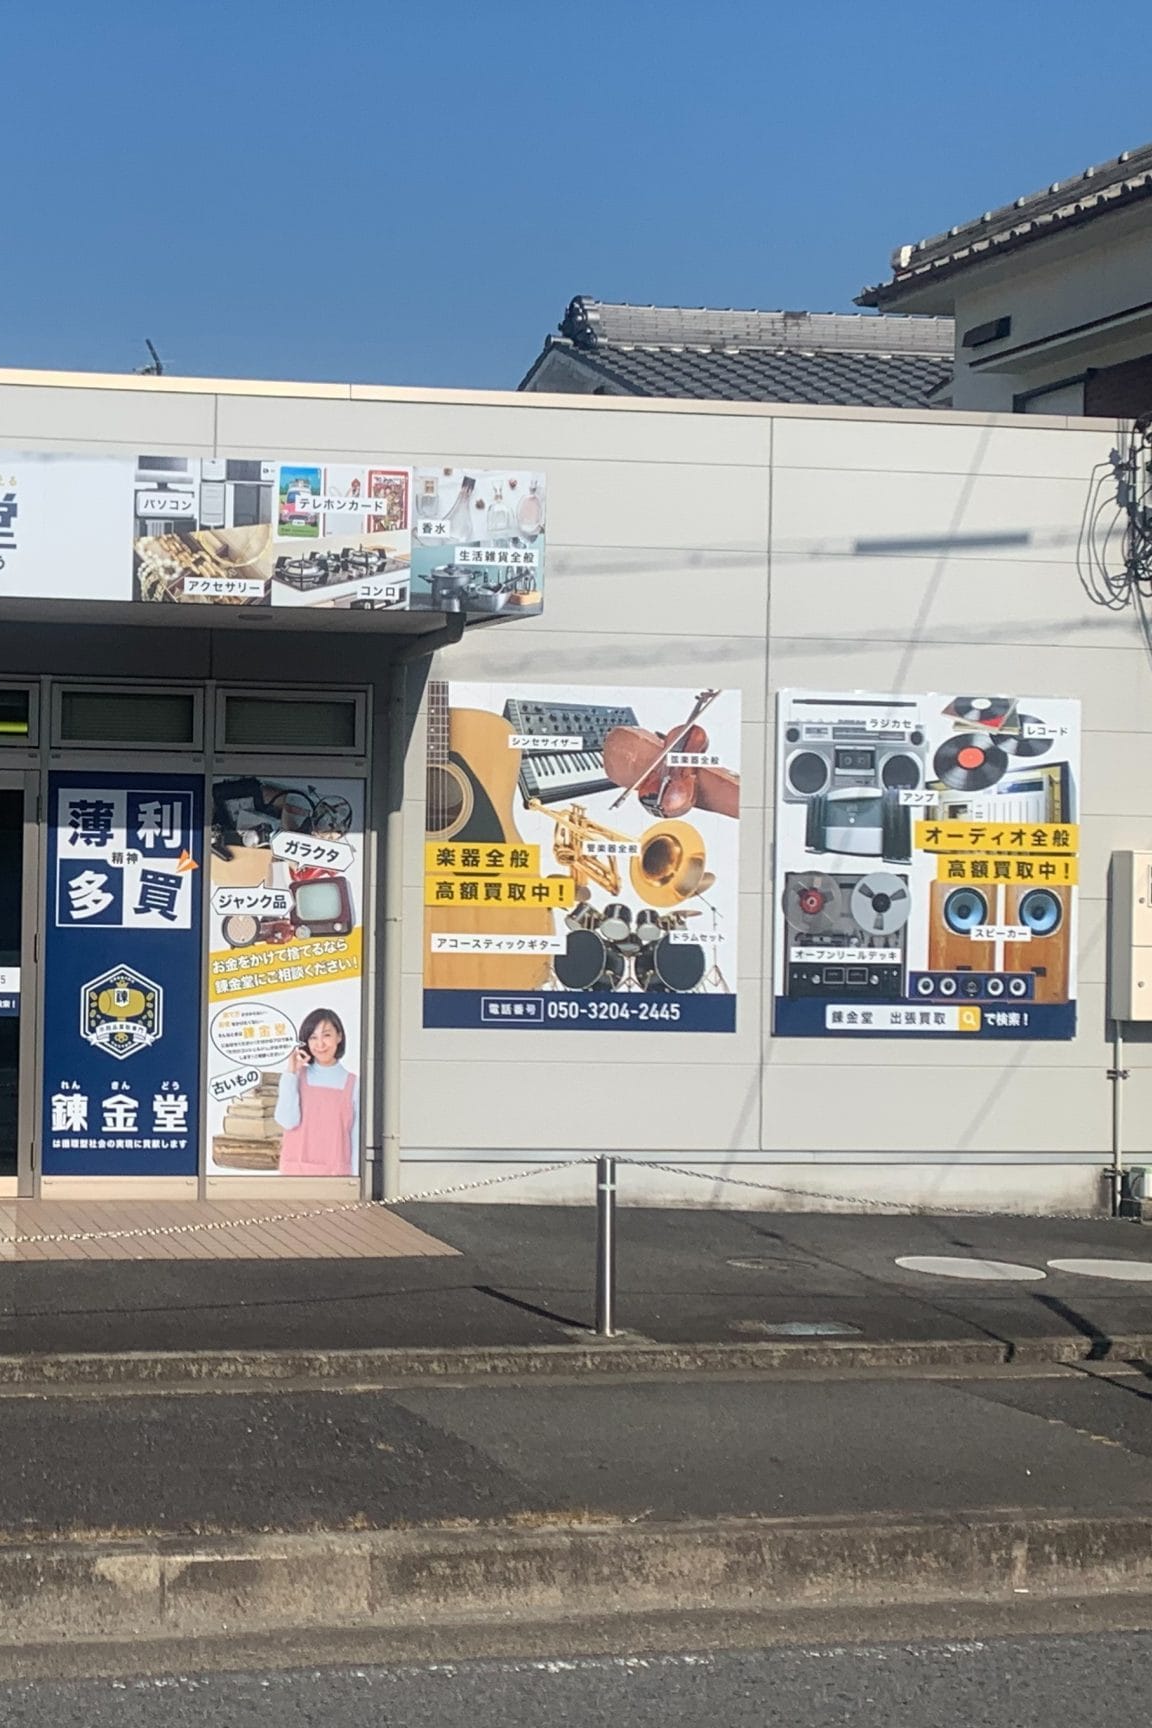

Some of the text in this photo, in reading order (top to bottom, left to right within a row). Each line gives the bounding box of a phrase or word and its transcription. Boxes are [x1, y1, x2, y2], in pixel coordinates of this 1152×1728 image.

[144, 498, 193, 512] パソコン
[299, 498, 383, 511] テレホンカード
[421, 521, 446, 535] 香水
[459, 549, 535, 564] 生活雑貨全般
[189, 580, 260, 594] アクセサリー
[360, 586, 396, 598] コンロ
[869, 719, 912, 729] ラジカセ
[1027, 726, 1068, 736] レコード
[512, 737, 579, 747] シンセサイザー
[903, 792, 935, 803] アンプ
[925, 827, 1070, 848] オーディオ全般
[284, 839, 340, 862] ガラクタ
[112, 852, 138, 864] 精神
[437, 848, 529, 868] 楽器全般
[948, 860, 1070, 880] 高額買取中！
[436, 881, 565, 902] 高額買取中！
[219, 895, 287, 910] ジャンク品
[672, 932, 725, 943] ドラムセット
[975, 927, 1028, 938] スピーカー
[437, 938, 560, 951] アコースティックギター
[212, 938, 348, 974] お金をかけて捨てるなら
[795, 950, 897, 960] オープンリールデッキ
[489, 1002, 681, 1020] 電話番号 050-3204-2445
[889, 1011, 946, 1025] 出張買取
[984, 1012, 1029, 1026] で検索！
[61, 1081, 180, 1091] れん きん どう
[212, 1070, 259, 1095] 古いもの
[51, 1093, 188, 1132] 錬金堂
